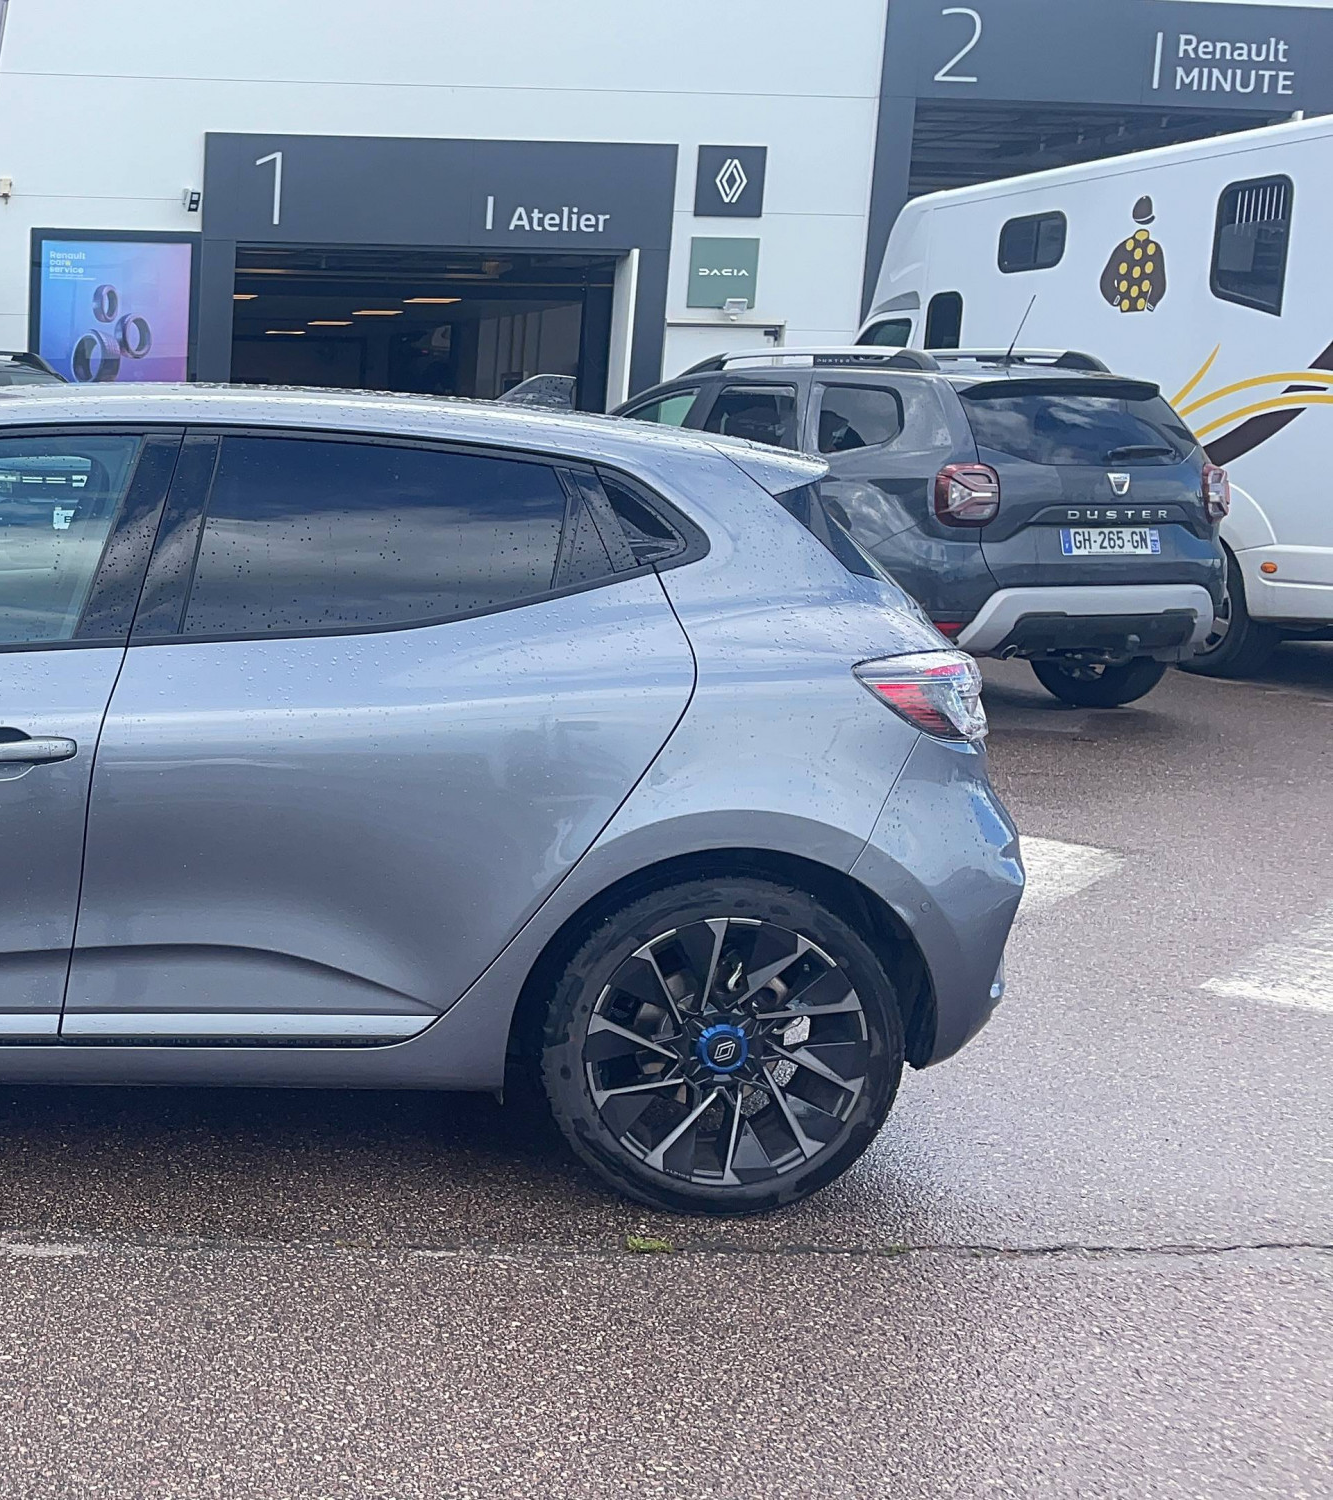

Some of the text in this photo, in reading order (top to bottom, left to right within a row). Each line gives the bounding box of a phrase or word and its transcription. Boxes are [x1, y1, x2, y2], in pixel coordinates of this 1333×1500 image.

[933, 7, 982, 83] 2
[1177, 33, 1289, 62] Renault
[1175, 66, 1295, 95] MINUTE
[255, 151, 283, 225] 1
[508, 206, 611, 232] Atelier
[49, 250, 86, 260] Renault
[698, 268, 749, 276] DACIA
[1067, 510, 1168, 520] DUSTER
[1073, 530, 1149, 550] GH-265-GN
